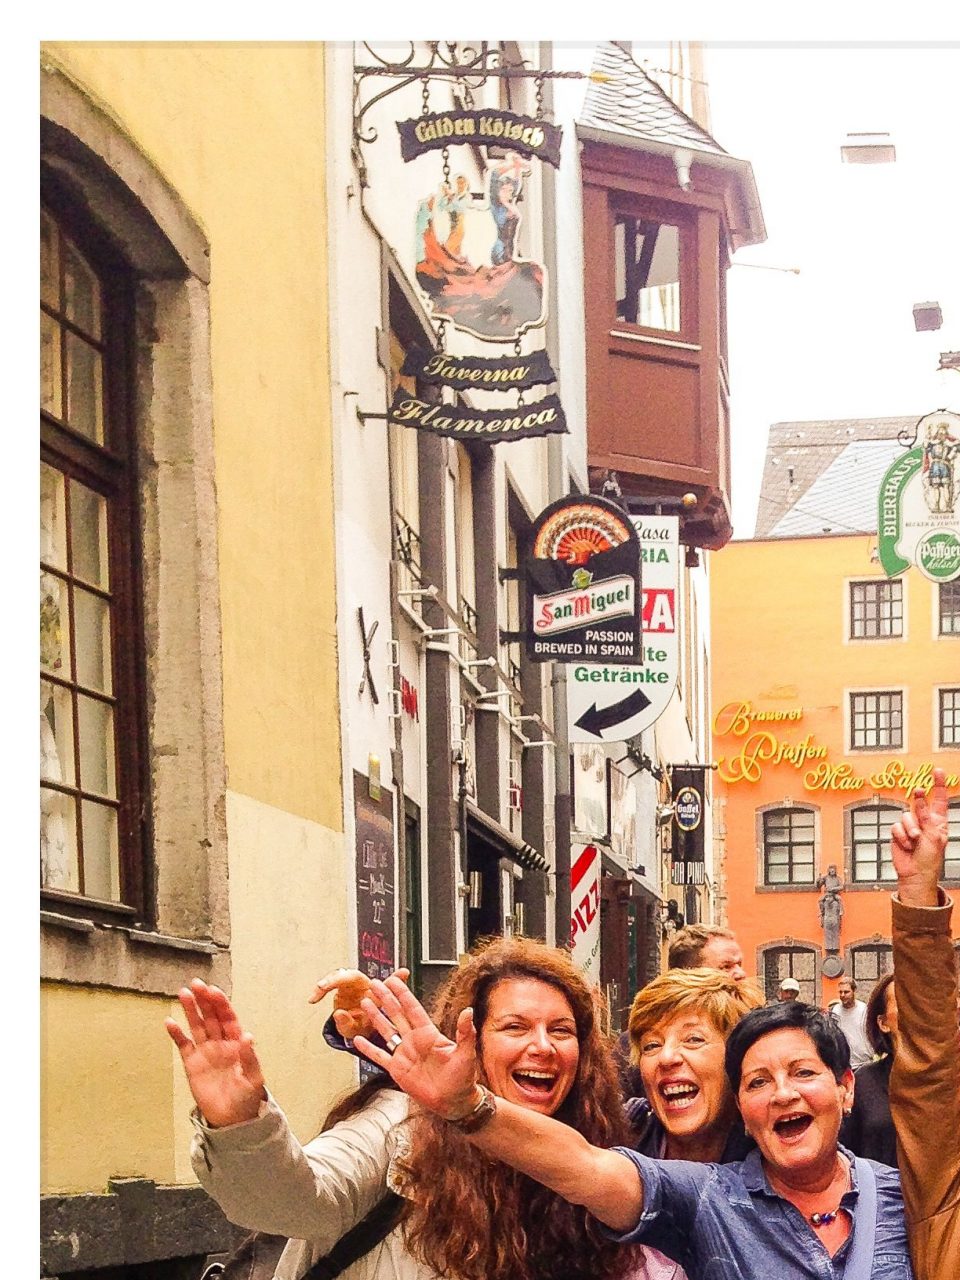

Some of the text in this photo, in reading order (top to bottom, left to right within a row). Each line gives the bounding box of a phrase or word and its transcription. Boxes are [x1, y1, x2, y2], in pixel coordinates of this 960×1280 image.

[479, 116, 545, 148] Kölsch
[423, 354, 531, 382] Taverna
[392, 399, 558, 433] Flamenca
[883, 457, 921, 537] BIERHAUS
[641, 549, 670, 563] RIA
[534, 642, 634, 656] BREWED IN SPAIN
[585, 630, 634, 643] PASSION
[574, 667, 669, 684] Getränke
[712, 701, 803, 736] Brauerei
[717, 731, 827, 783] Pfaffen
[870, 759, 959, 799] Päffgn
